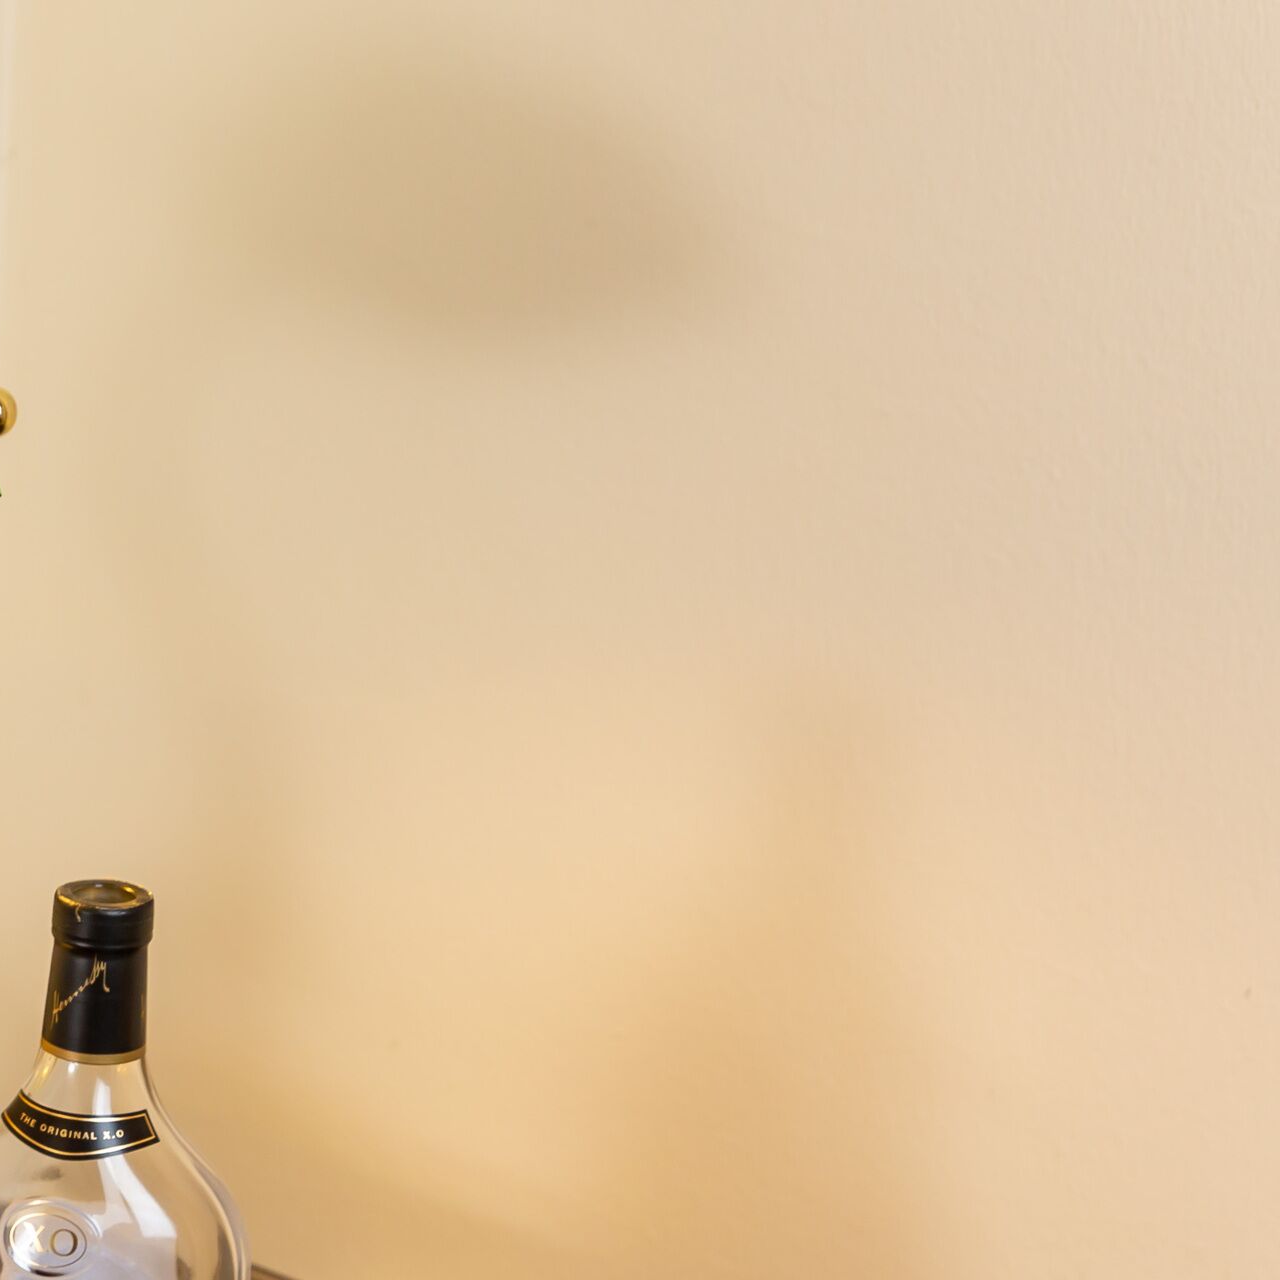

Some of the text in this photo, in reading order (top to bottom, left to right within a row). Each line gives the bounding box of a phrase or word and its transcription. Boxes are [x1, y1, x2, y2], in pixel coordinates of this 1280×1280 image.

[19, 1112, 125, 1141] THE ORIGINAL X.O
